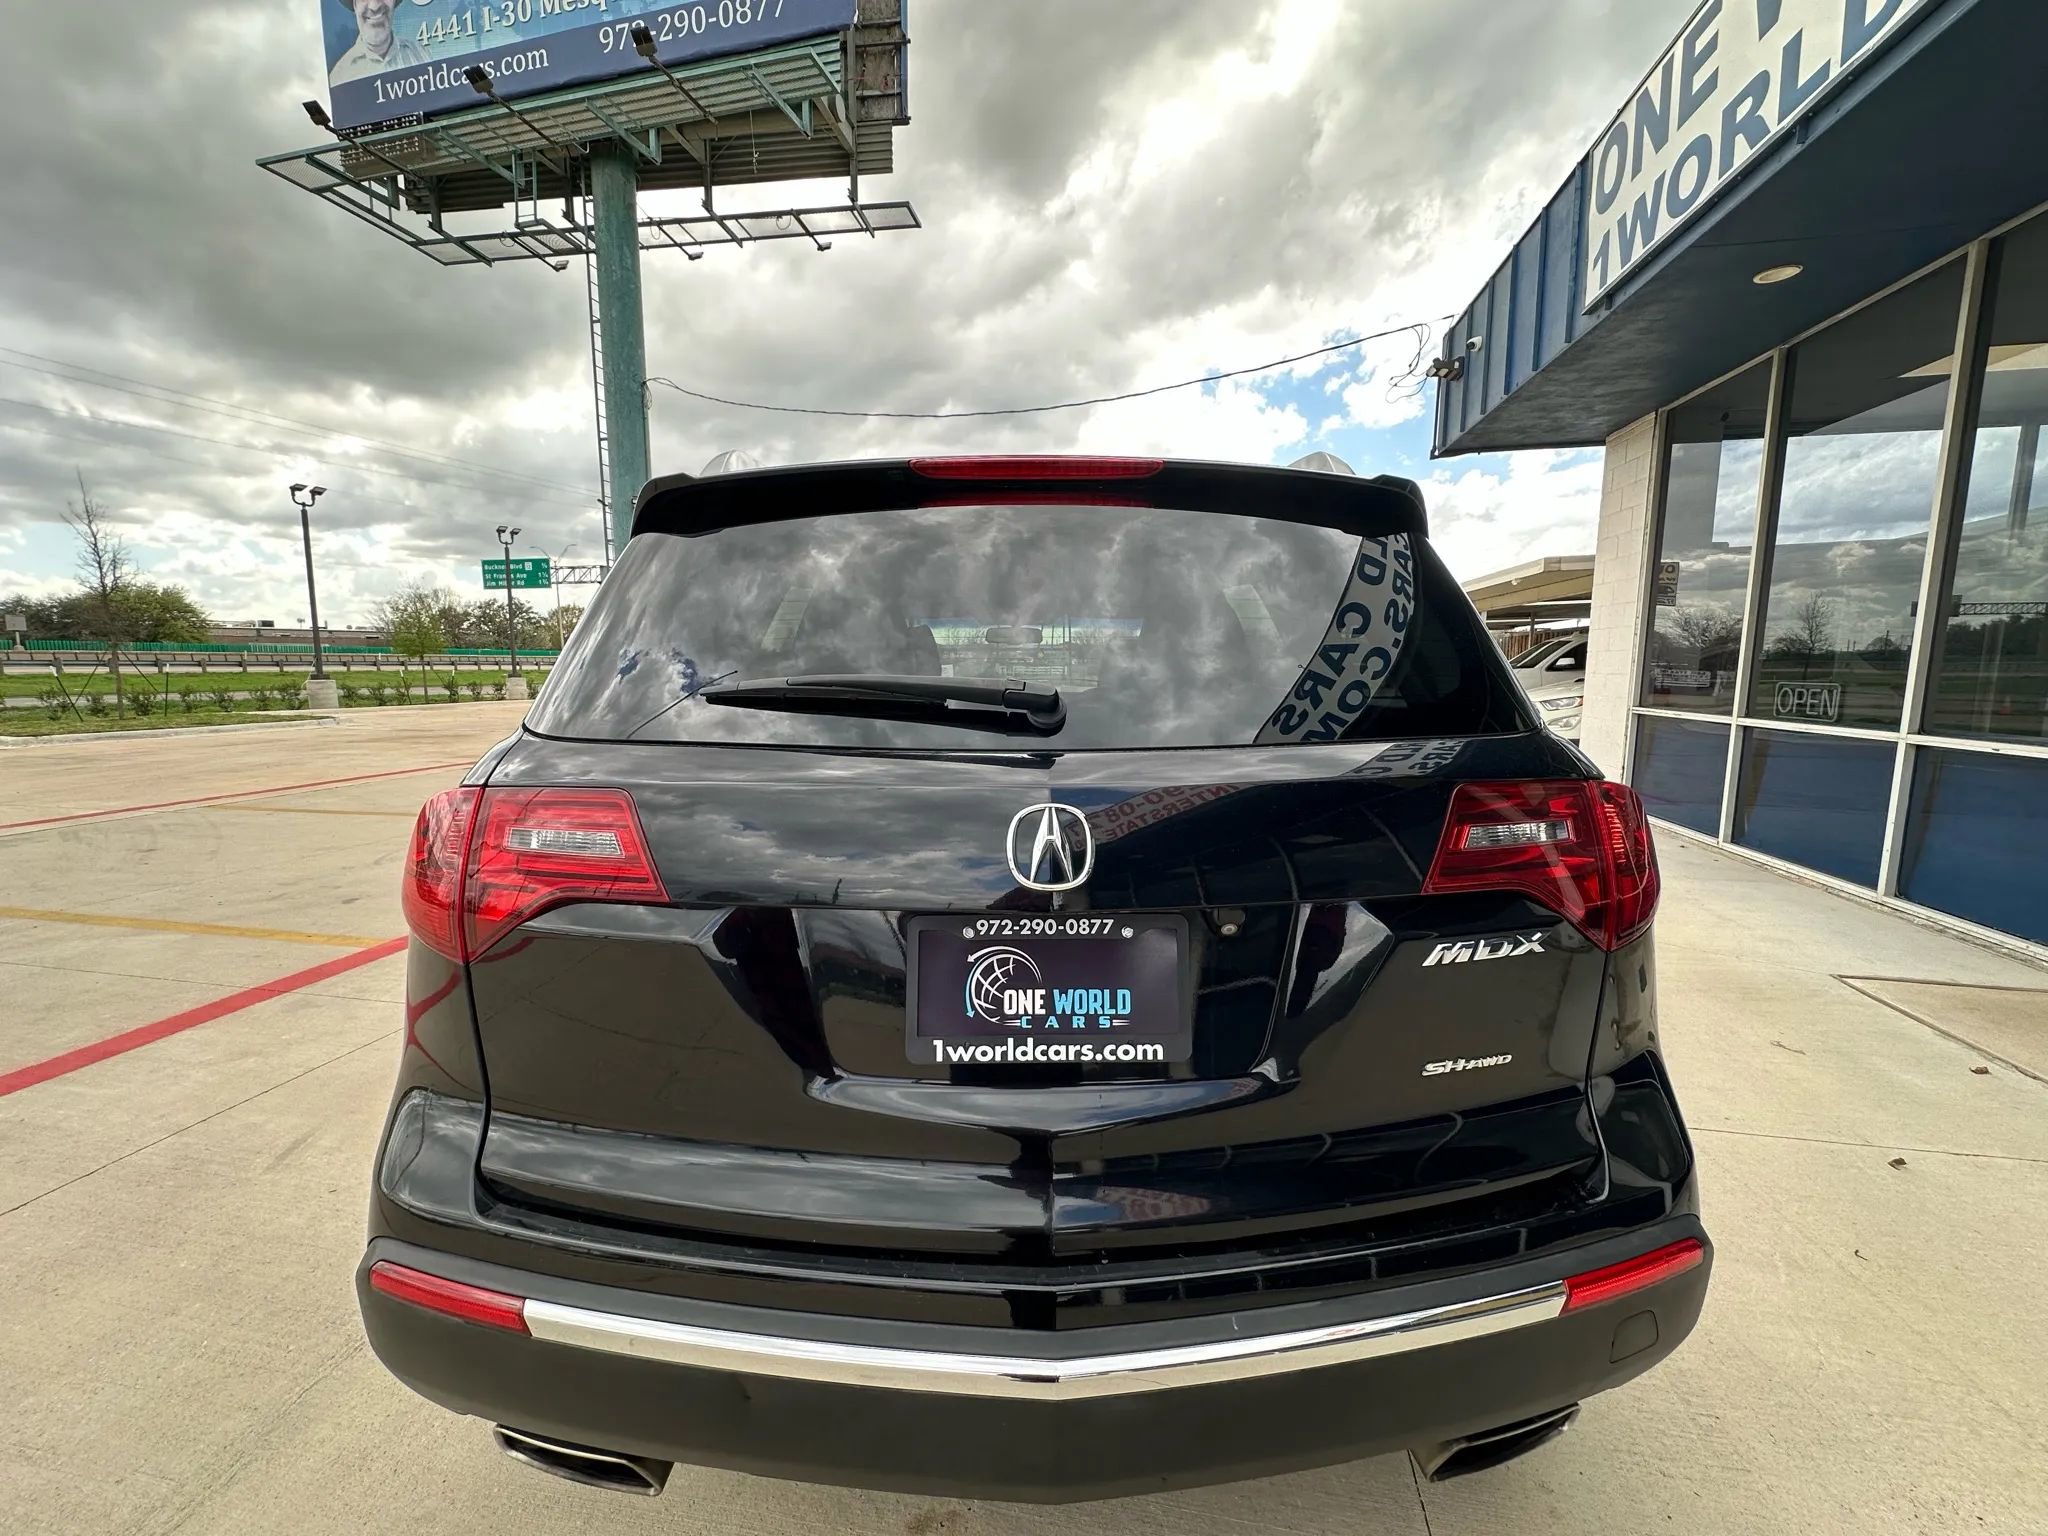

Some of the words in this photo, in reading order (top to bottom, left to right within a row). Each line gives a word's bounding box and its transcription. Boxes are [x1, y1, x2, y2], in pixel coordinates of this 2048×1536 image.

[415, 10, 477, 47] 4441
[482, 0, 533, 32] I-30
[373, 47, 549, 104] 1worldcas.com
[1777, 687, 1838, 717] OPEN
[976, 918, 1114, 935] 972-290-0877
[1422, 931, 1549, 967] MDX
[1003, 988, 1046, 1015] ONE
[1053, 988, 1132, 1015] WORLD
[1021, 1015, 1112, 1029] CARS
[933, 1037, 1164, 1062] 1worldcars.com
